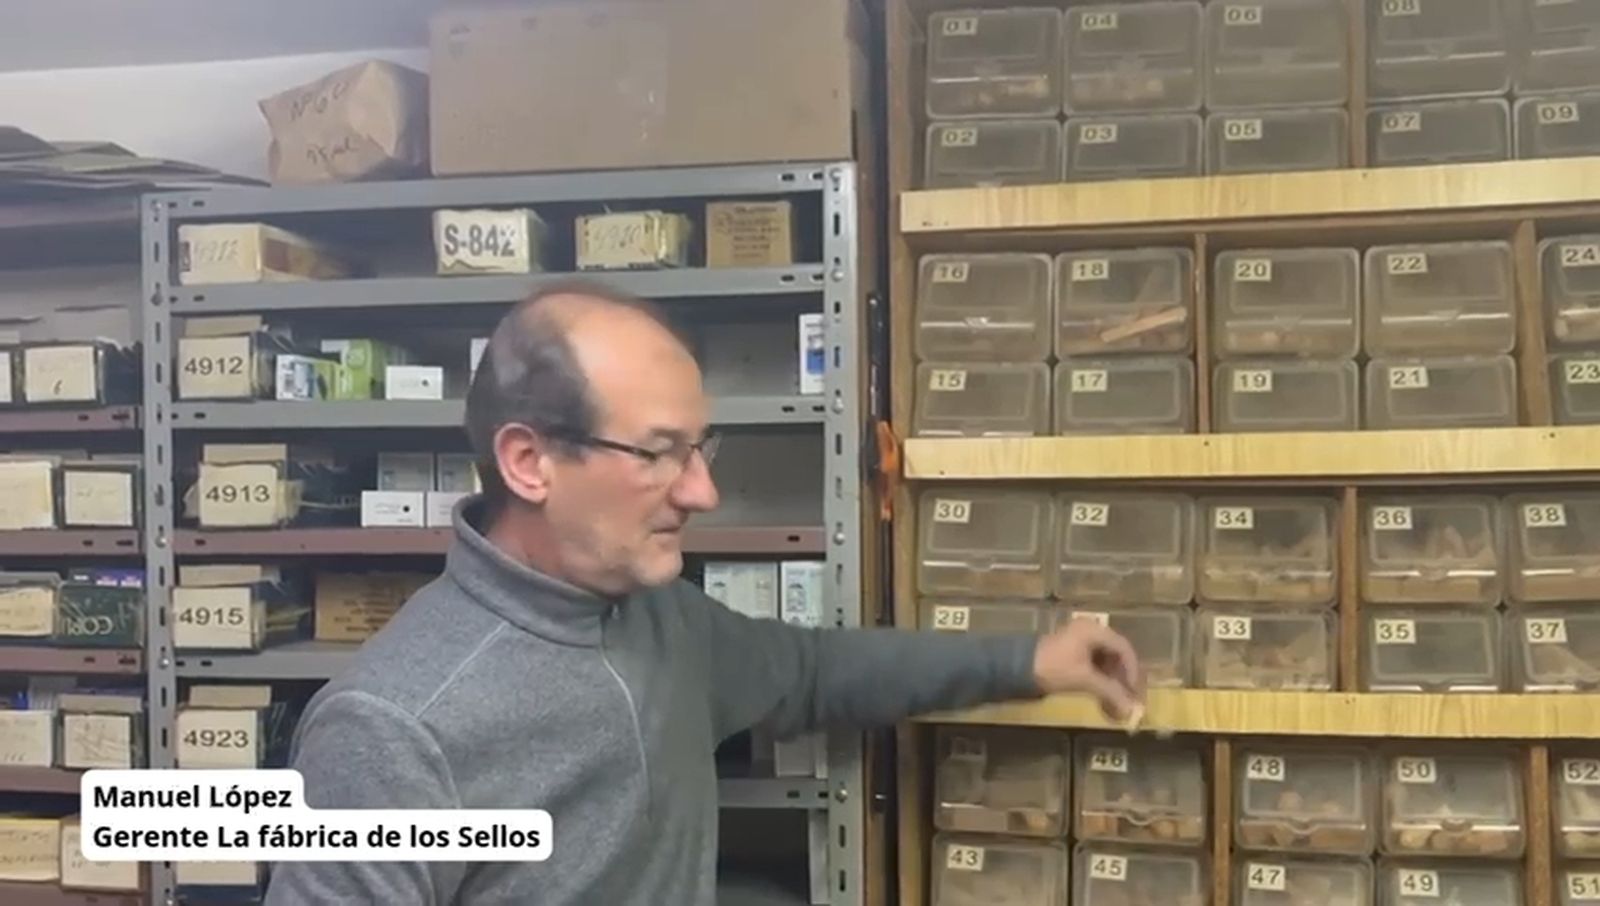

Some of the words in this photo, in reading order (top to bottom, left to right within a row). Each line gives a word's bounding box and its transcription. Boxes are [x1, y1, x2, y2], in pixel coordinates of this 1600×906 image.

[1083, 14, 1113, 28] 04
[1226, 8, 1258, 22] 06
[945, 20, 974, 33] 01
[1541, 105, 1575, 120] 09
[1384, 115, 1416, 130] 07
[945, 130, 974, 144] 02
[1083, 127, 1113, 141] 03
[1227, 123, 1258, 139] 05
[443, 222, 516, 257] S-842
[1565, 247, 1596, 263] 24
[1078, 263, 1105, 277] 18
[1237, 263, 1268, 278] 20
[1391, 257, 1422, 273] 22
[940, 267, 963, 280] 16
[184, 357, 244, 376] 4912
[1569, 364, 1600, 379] 23
[938, 373, 962, 388] 15
[1078, 373, 1104, 388] 17
[1239, 373, 1268, 388] 19
[1392, 370, 1421, 386] 21
[205, 484, 271, 503] 4913
[938, 504, 966, 520] 30
[1075, 506, 1104, 522] 32
[1219, 510, 1250, 526] 34
[1375, 510, 1408, 526] 36
[1528, 506, 1561, 523] 38
[179, 608, 245, 626] 4915
[1217, 620, 1247, 636] 33
[1379, 623, 1411, 639] 35
[1529, 622, 1561, 638] 37
[183, 729, 250, 749] 4923
[1094, 753, 1122, 769] 46
[1250, 760, 1281, 777] 48
[1401, 761, 1431, 778] 50
[1568, 762, 1599, 780] 52
[949, 849, 979, 867] 43
[1093, 859, 1122, 876] 45
[1251, 868, 1281, 885] 47
[1403, 875, 1434, 892] 49
[1572, 876, 1600, 895] 51
